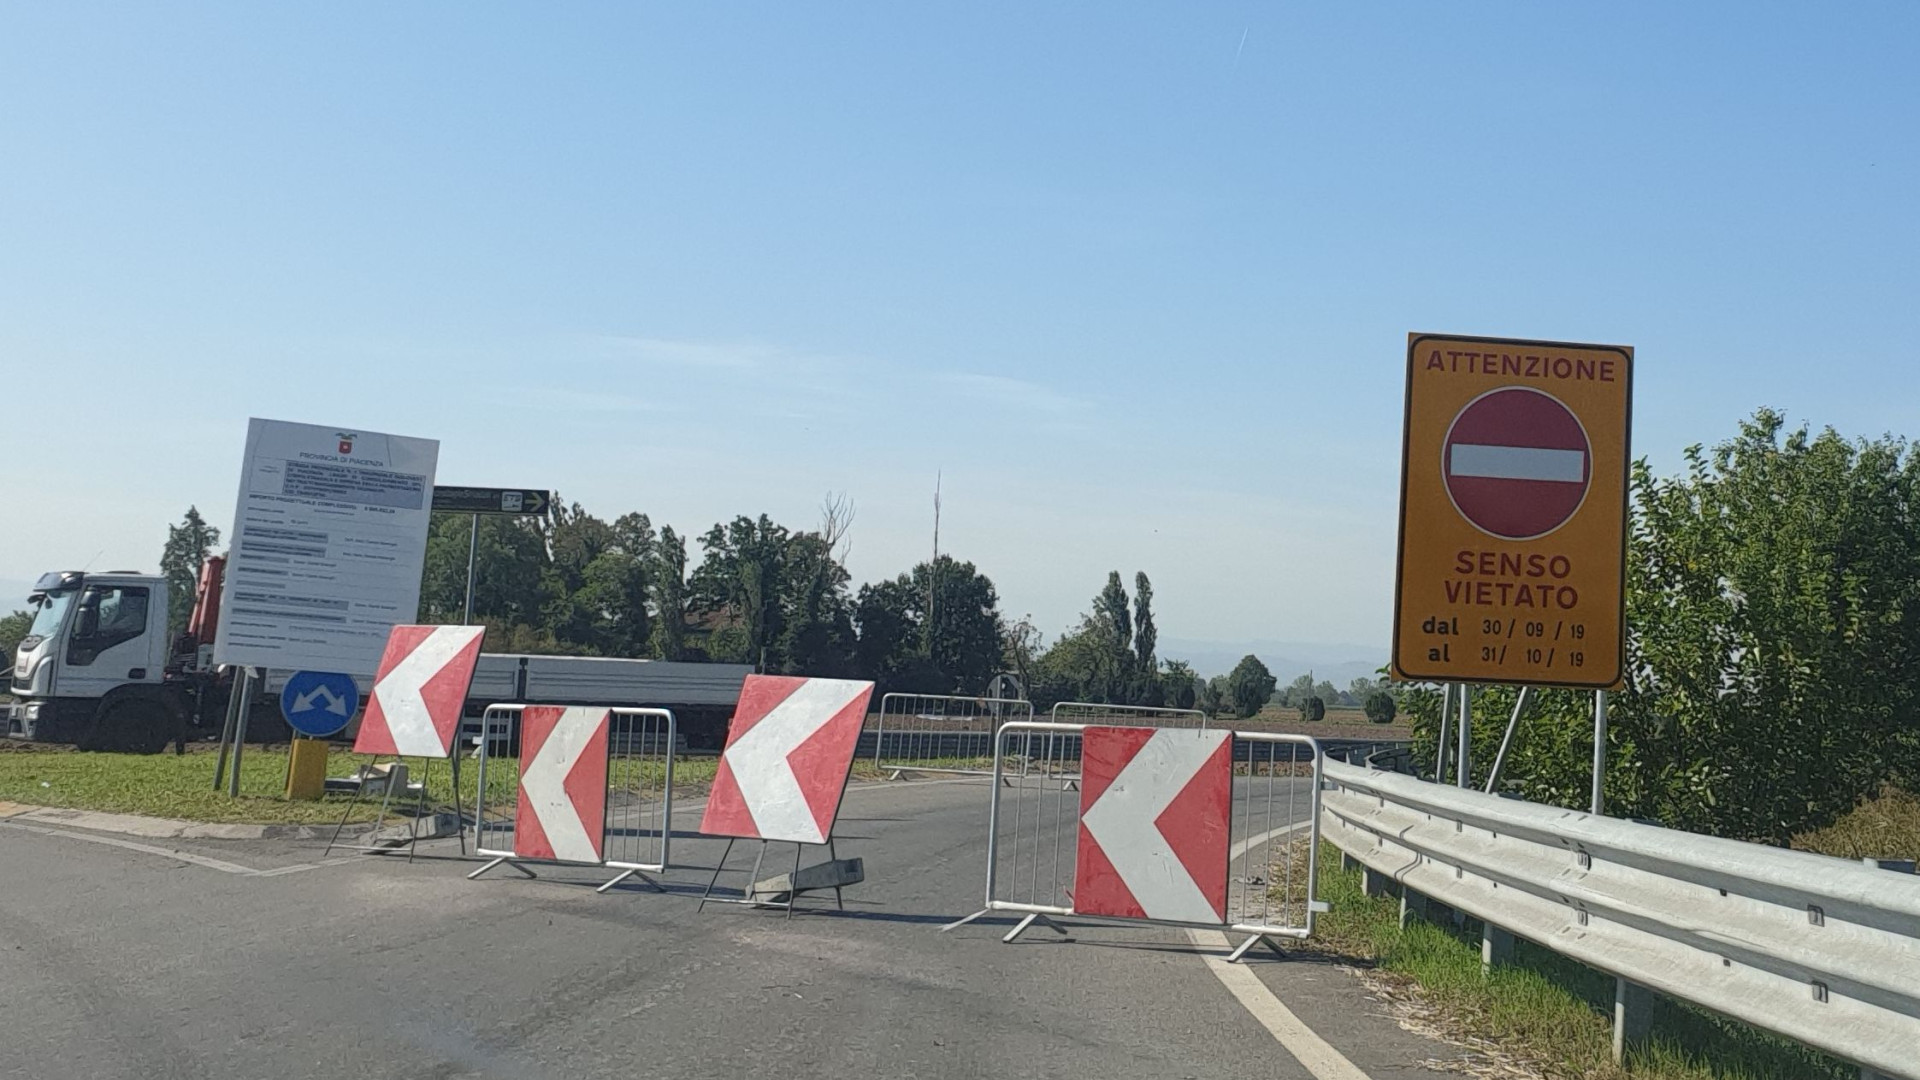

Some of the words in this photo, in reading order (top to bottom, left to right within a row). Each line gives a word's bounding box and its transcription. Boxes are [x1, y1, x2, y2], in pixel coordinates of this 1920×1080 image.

[1426, 350, 1615, 382] ATTENZIONE
[300, 452, 338, 463] PROVINCIA
[349, 456, 384, 467] PIACENZA
[1454, 550, 1571, 579] SENSO
[1444, 580, 1578, 609] VIETATO
[1422, 616, 1459, 636] dal
[1428, 644, 1450, 663] al
